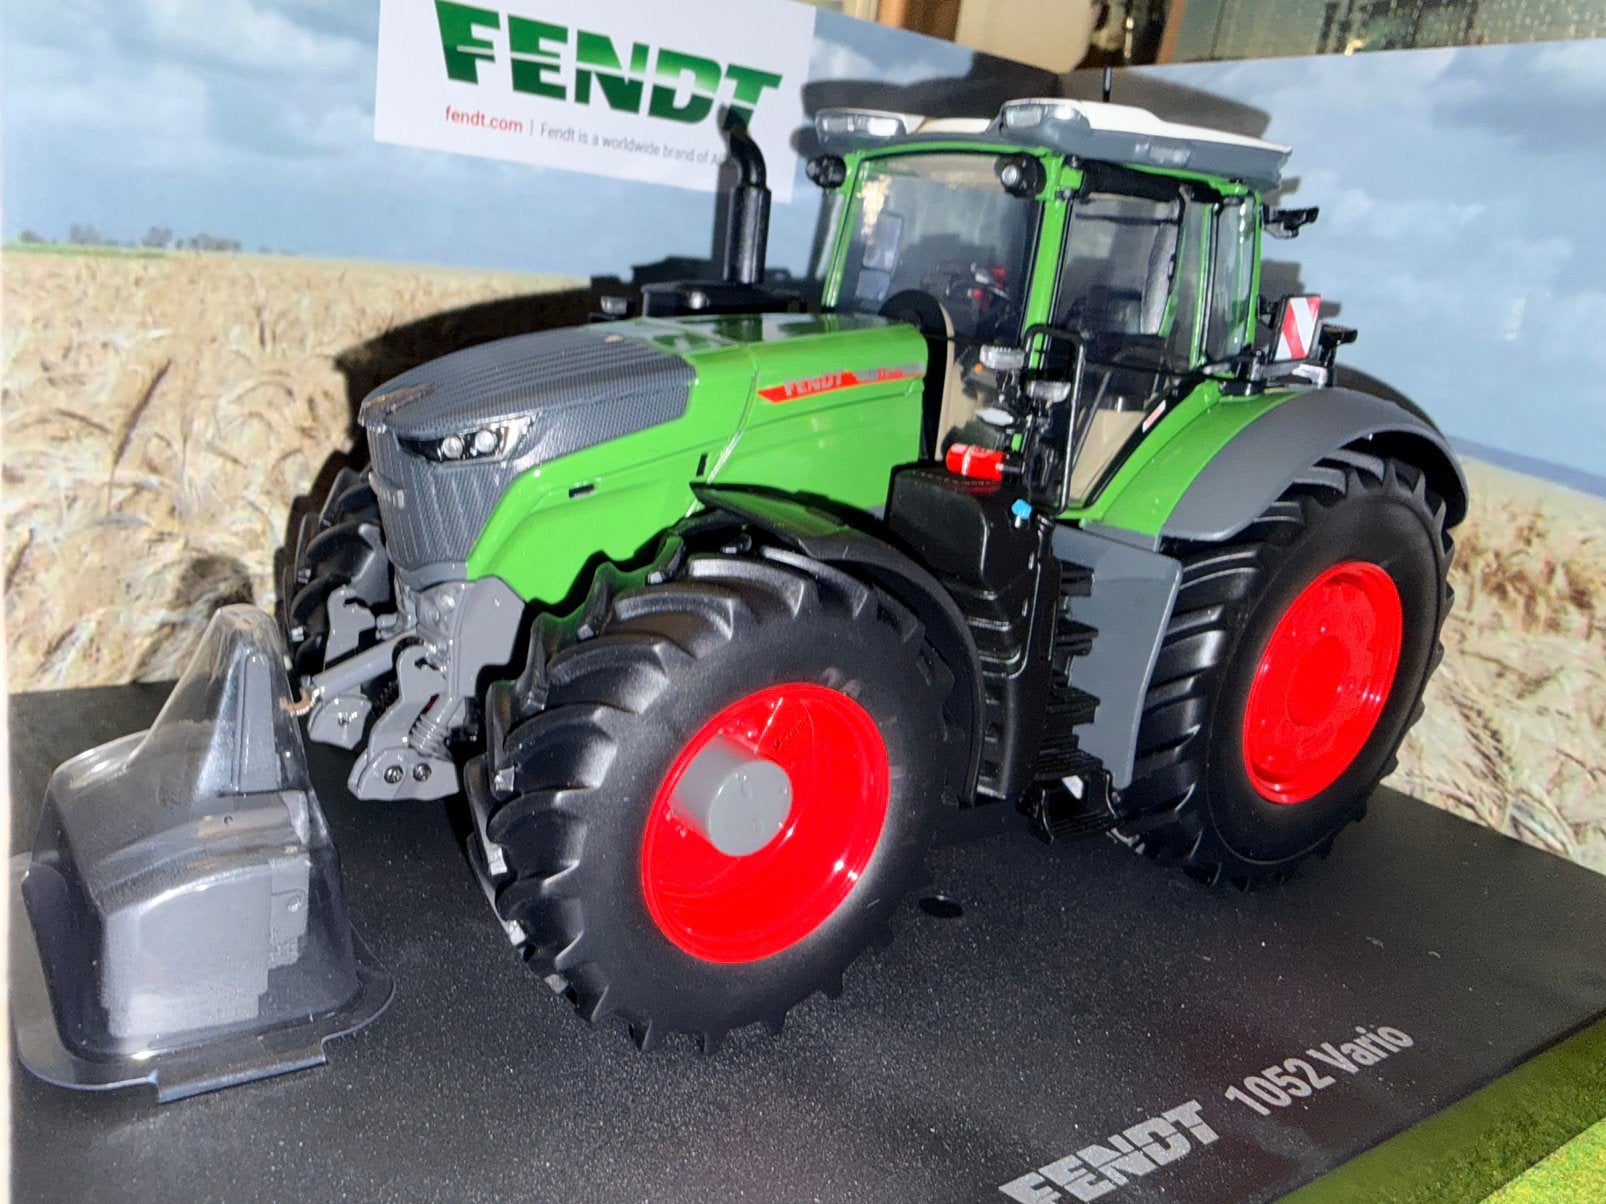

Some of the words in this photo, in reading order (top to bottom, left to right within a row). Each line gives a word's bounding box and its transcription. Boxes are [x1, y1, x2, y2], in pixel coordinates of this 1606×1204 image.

[434, 0, 783, 131] FENDT
[445, 104, 523, 134] fendt.com
[541, 121, 575, 143] Fendt
[578, 130, 589, 145] is
[591, 134, 599, 147] a
[602, 135, 661, 157] worldwide
[663, 144, 695, 163] brand
[696, 151, 709, 164] of
[998, 1099, 1220, 1204] FENDT
[1225, 1057, 1336, 1117] 1052
[1306, 1025, 1415, 1075] Vario
